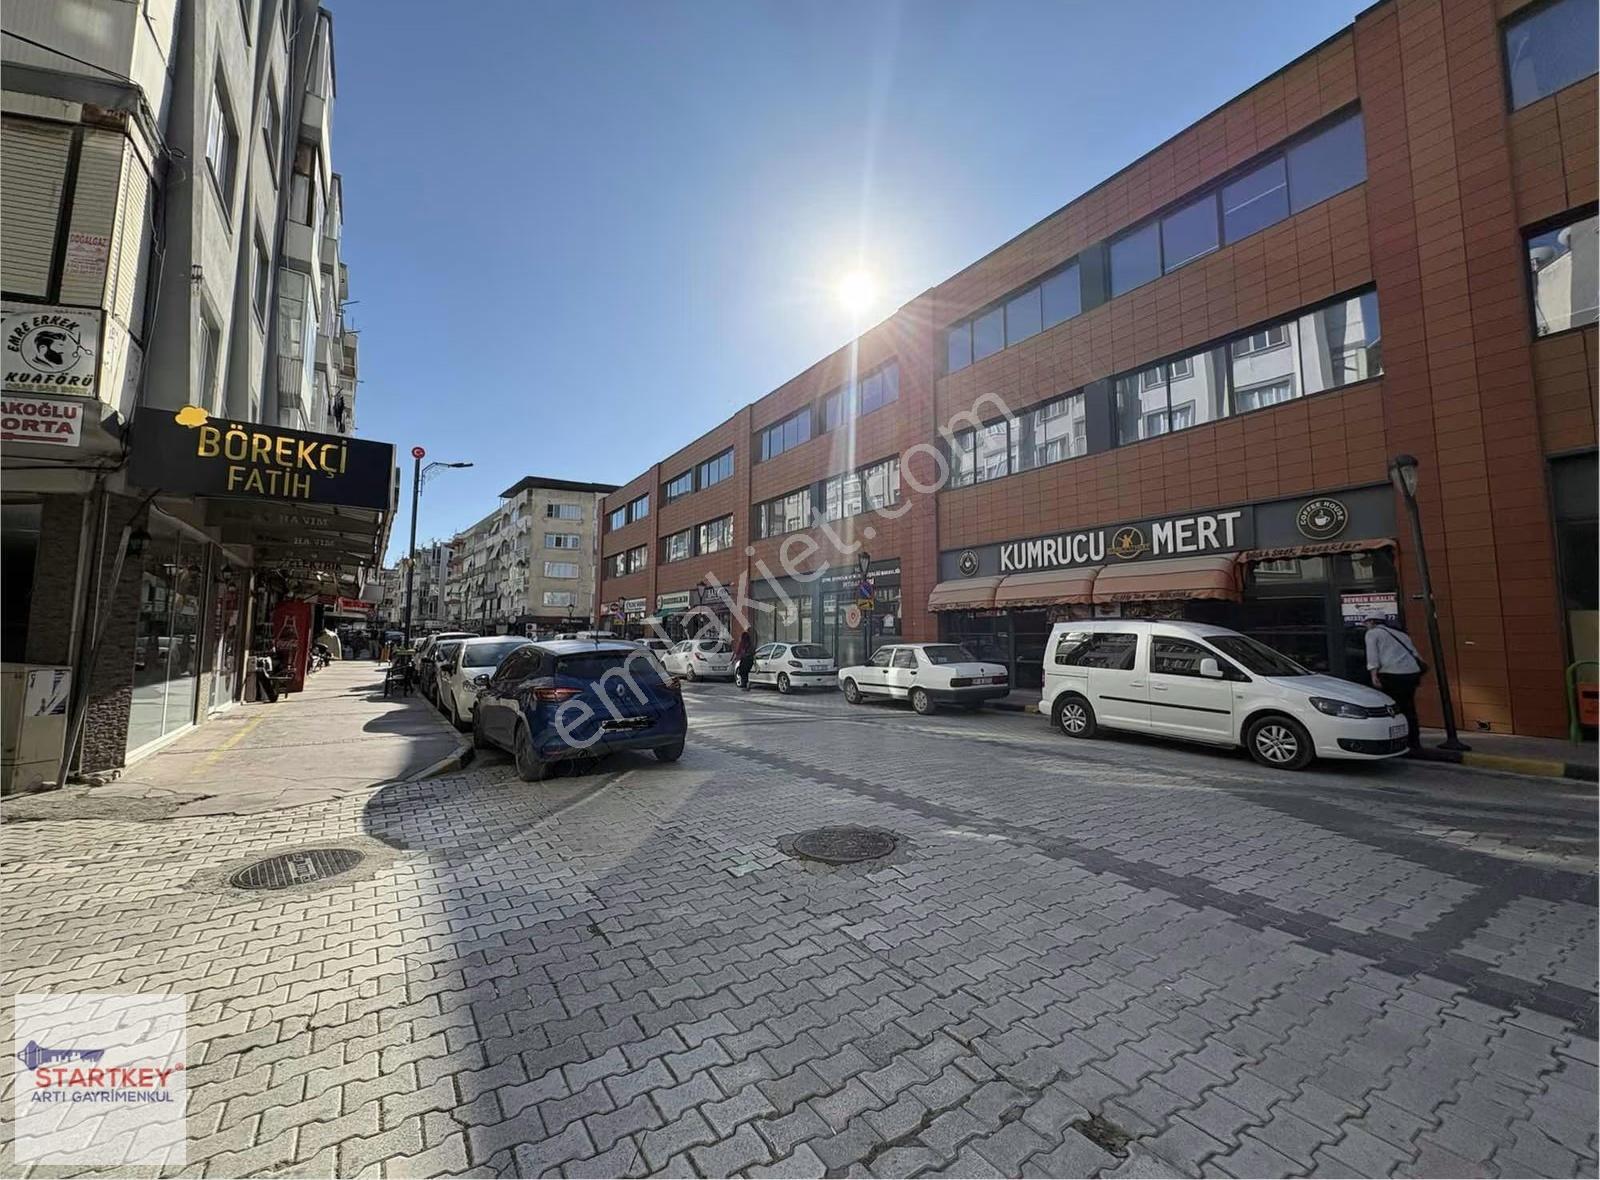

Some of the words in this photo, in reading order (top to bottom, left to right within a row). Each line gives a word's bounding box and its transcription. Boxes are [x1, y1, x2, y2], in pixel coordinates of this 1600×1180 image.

[7, 321, 31, 353] EMRE
[33, 314, 80, 331] ERKEK
[4, 371, 94, 387] KUAFÖRÜ
[197, 424, 347, 479] BÖREKÇİ
[227, 466, 312, 499] FATİH
[1300, 502, 1321, 525] COFFEE
[1323, 501, 1344, 521] HOUSE
[1001, 531, 1105, 571] KUMRUCU
[1151, 511, 1241, 555] MERT
